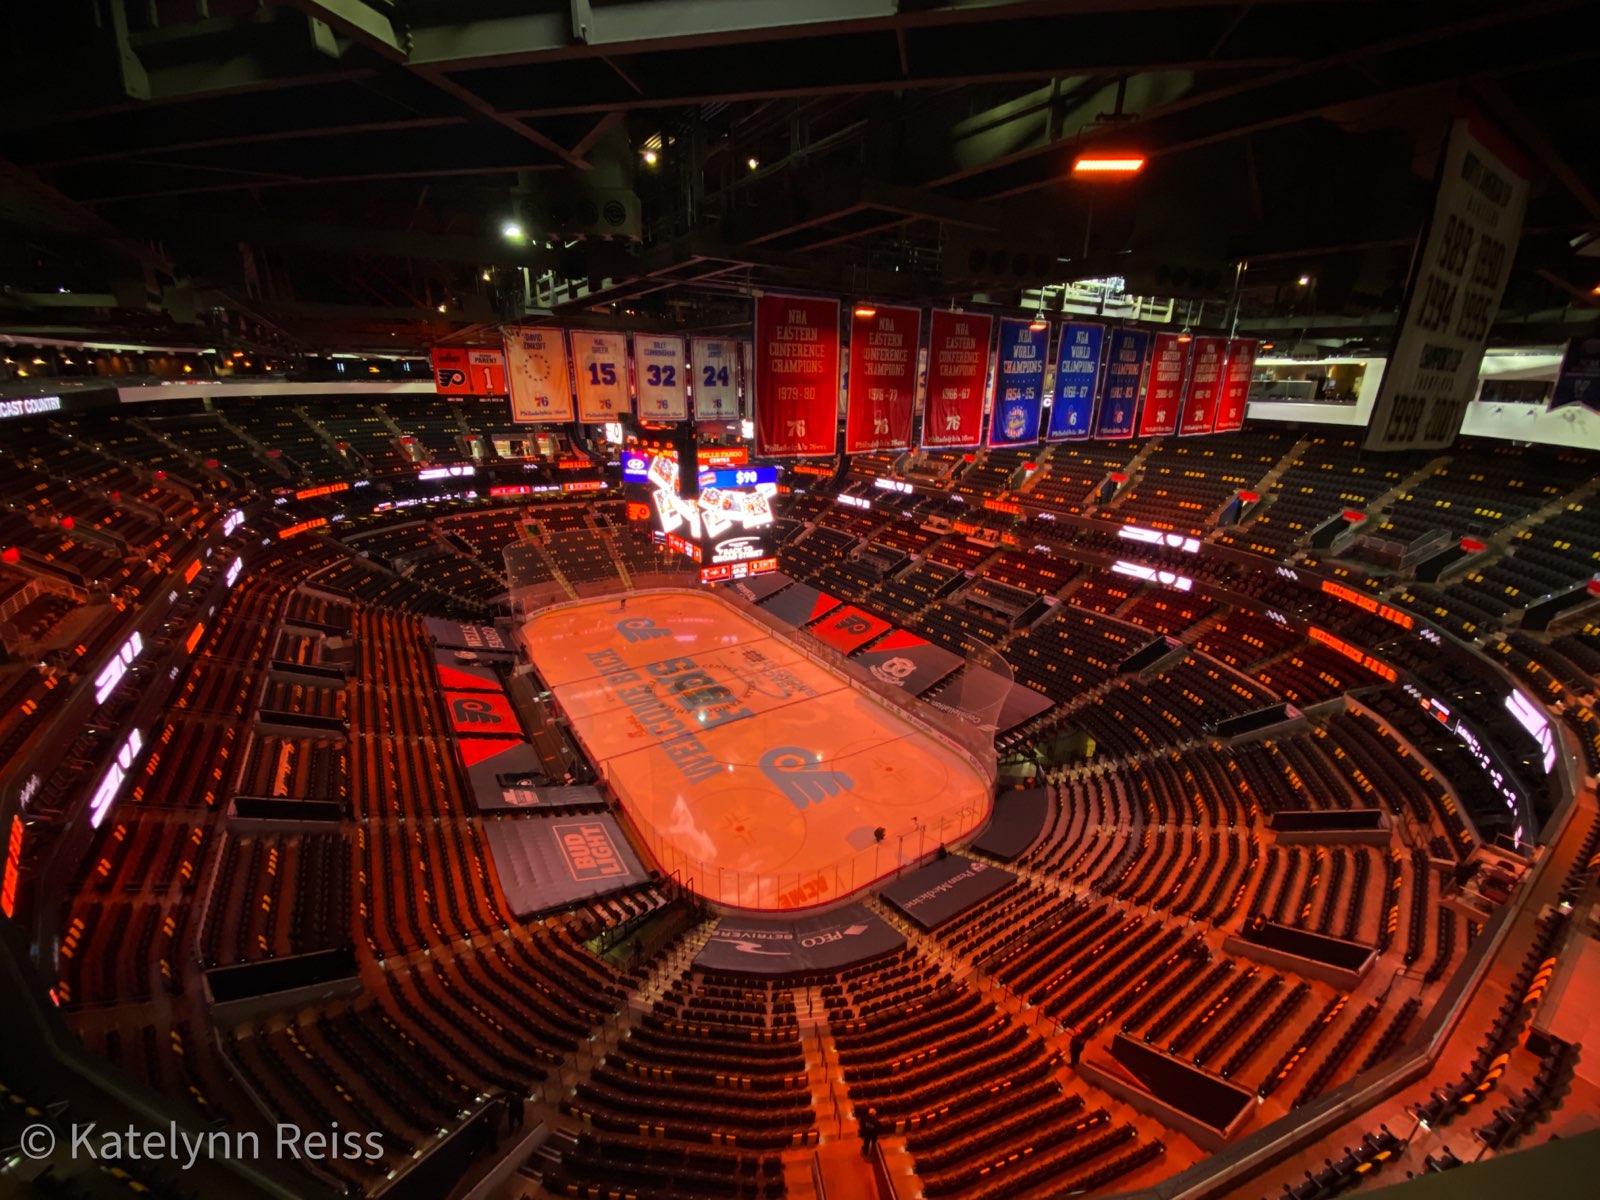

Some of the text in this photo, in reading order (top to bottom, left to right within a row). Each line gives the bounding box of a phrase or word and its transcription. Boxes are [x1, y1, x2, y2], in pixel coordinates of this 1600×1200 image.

[788, 310, 807, 325] NBA
[879, 317, 895, 332] NBA
[777, 326, 818, 341] EASTERN
[955, 323, 969, 335] NBA
[1018, 329, 1032, 343] NBA
[525, 333, 543, 342] DAVID
[869, 332, 903, 347] EASTERN
[945, 337, 976, 350] EASTERN
[1076, 331, 1089, 344] NBA
[769, 342, 825, 358] CONFERENCE
[863, 348, 908, 362] CONFERENCE
[939, 351, 980, 364] CONFERENCE
[1012, 344, 1036, 358] WORLD
[1071, 346, 1091, 359] WORLD
[474, 356, 498, 365] PARENT
[772, 359, 823, 373] CHAMPIONS
[1003, 360, 1043, 374] CHAMPIONS
[1061, 361, 1095, 373] CHAMPIONS
[588, 362, 617, 386] 15
[646, 364, 677, 387] 32
[702, 365, 729, 387] 24
[864, 363, 905, 376] CHAMPIONS
[939, 364, 977, 377] CHAMPIONS
[1111, 363, 1140, 375] CHAMPIONS
[483, 366, 494, 390] 1
[24, 396, 61, 414] COUNTRY
[535, 396, 549, 408] 76
[599, 399, 612, 409] 76
[657, 400, 669, 409] 76
[787, 419, 806, 437] 76
[873, 418, 889, 435] 76
[946, 415, 961, 431] 76
[735, 470, 758, 485] $90
[584, 647, 724, 785] WELCOME BACK
[930, 700, 982, 724] Constellation
[563, 832, 598, 870] BUD
[579, 826, 622, 875] LIGHT
[775, 875, 829, 909] ACME
[903, 868, 977, 909] Penn Medicine
[801, 930, 843, 948] PECO
